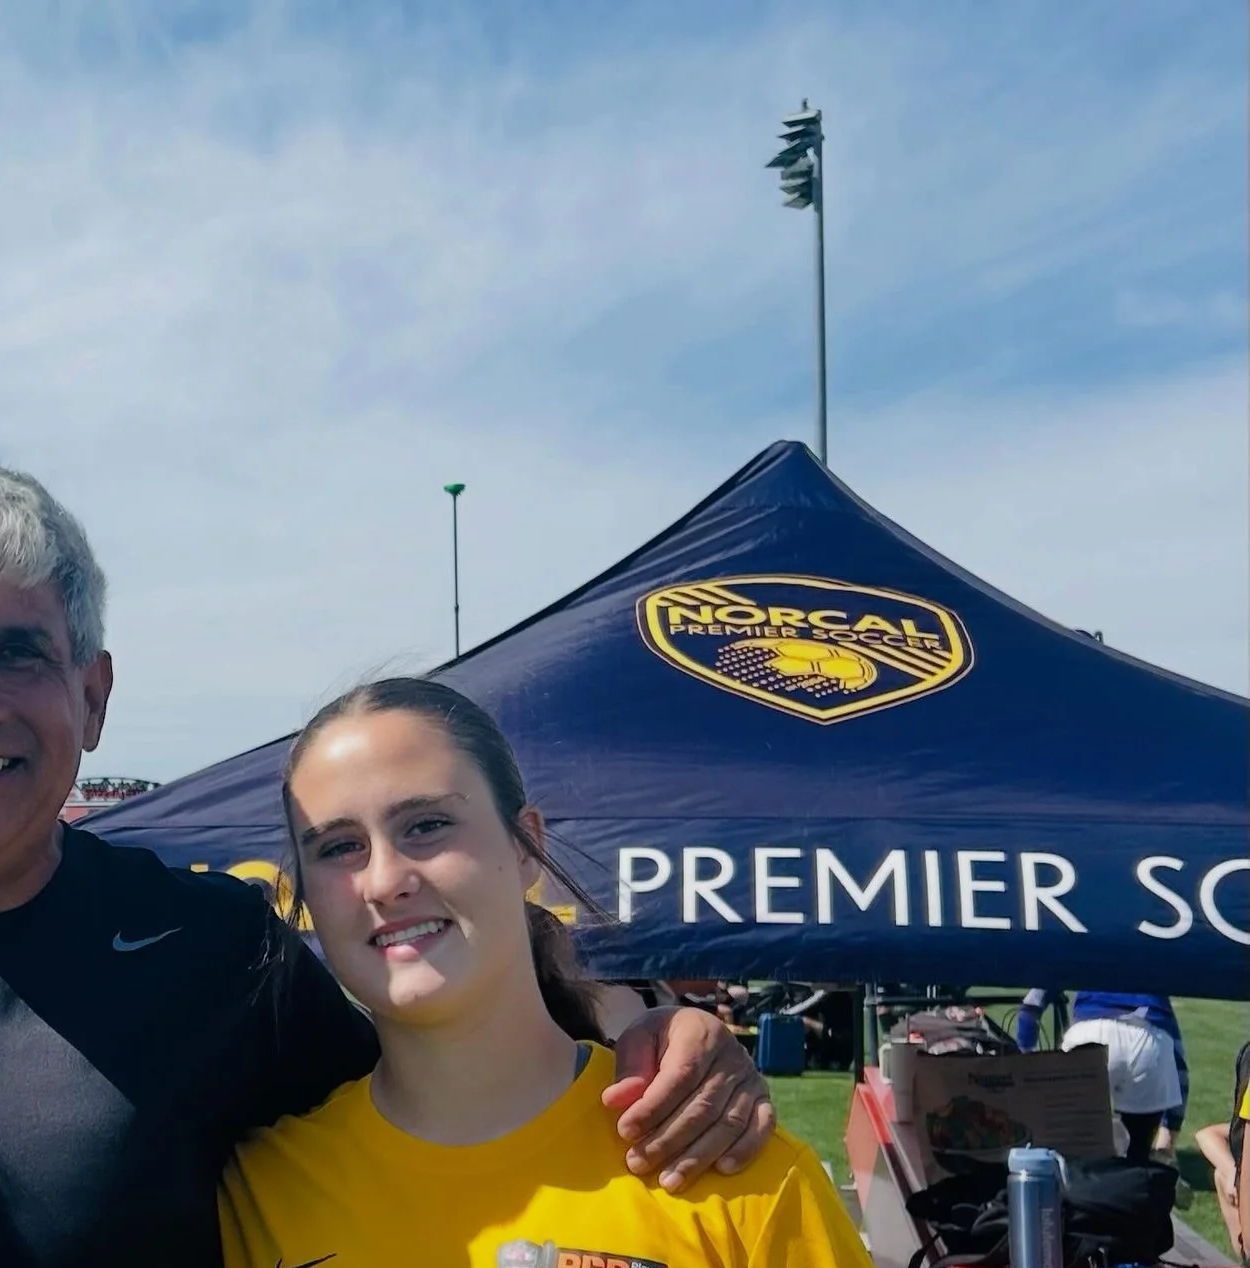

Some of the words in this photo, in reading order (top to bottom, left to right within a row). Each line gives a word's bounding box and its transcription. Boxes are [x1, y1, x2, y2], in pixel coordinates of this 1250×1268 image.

[668, 605, 939, 640] NORCAL
[670, 624, 799, 638] PREMIER
[812, 628, 943, 650] SOCCER
[617, 846, 1088, 934] PREMIER
